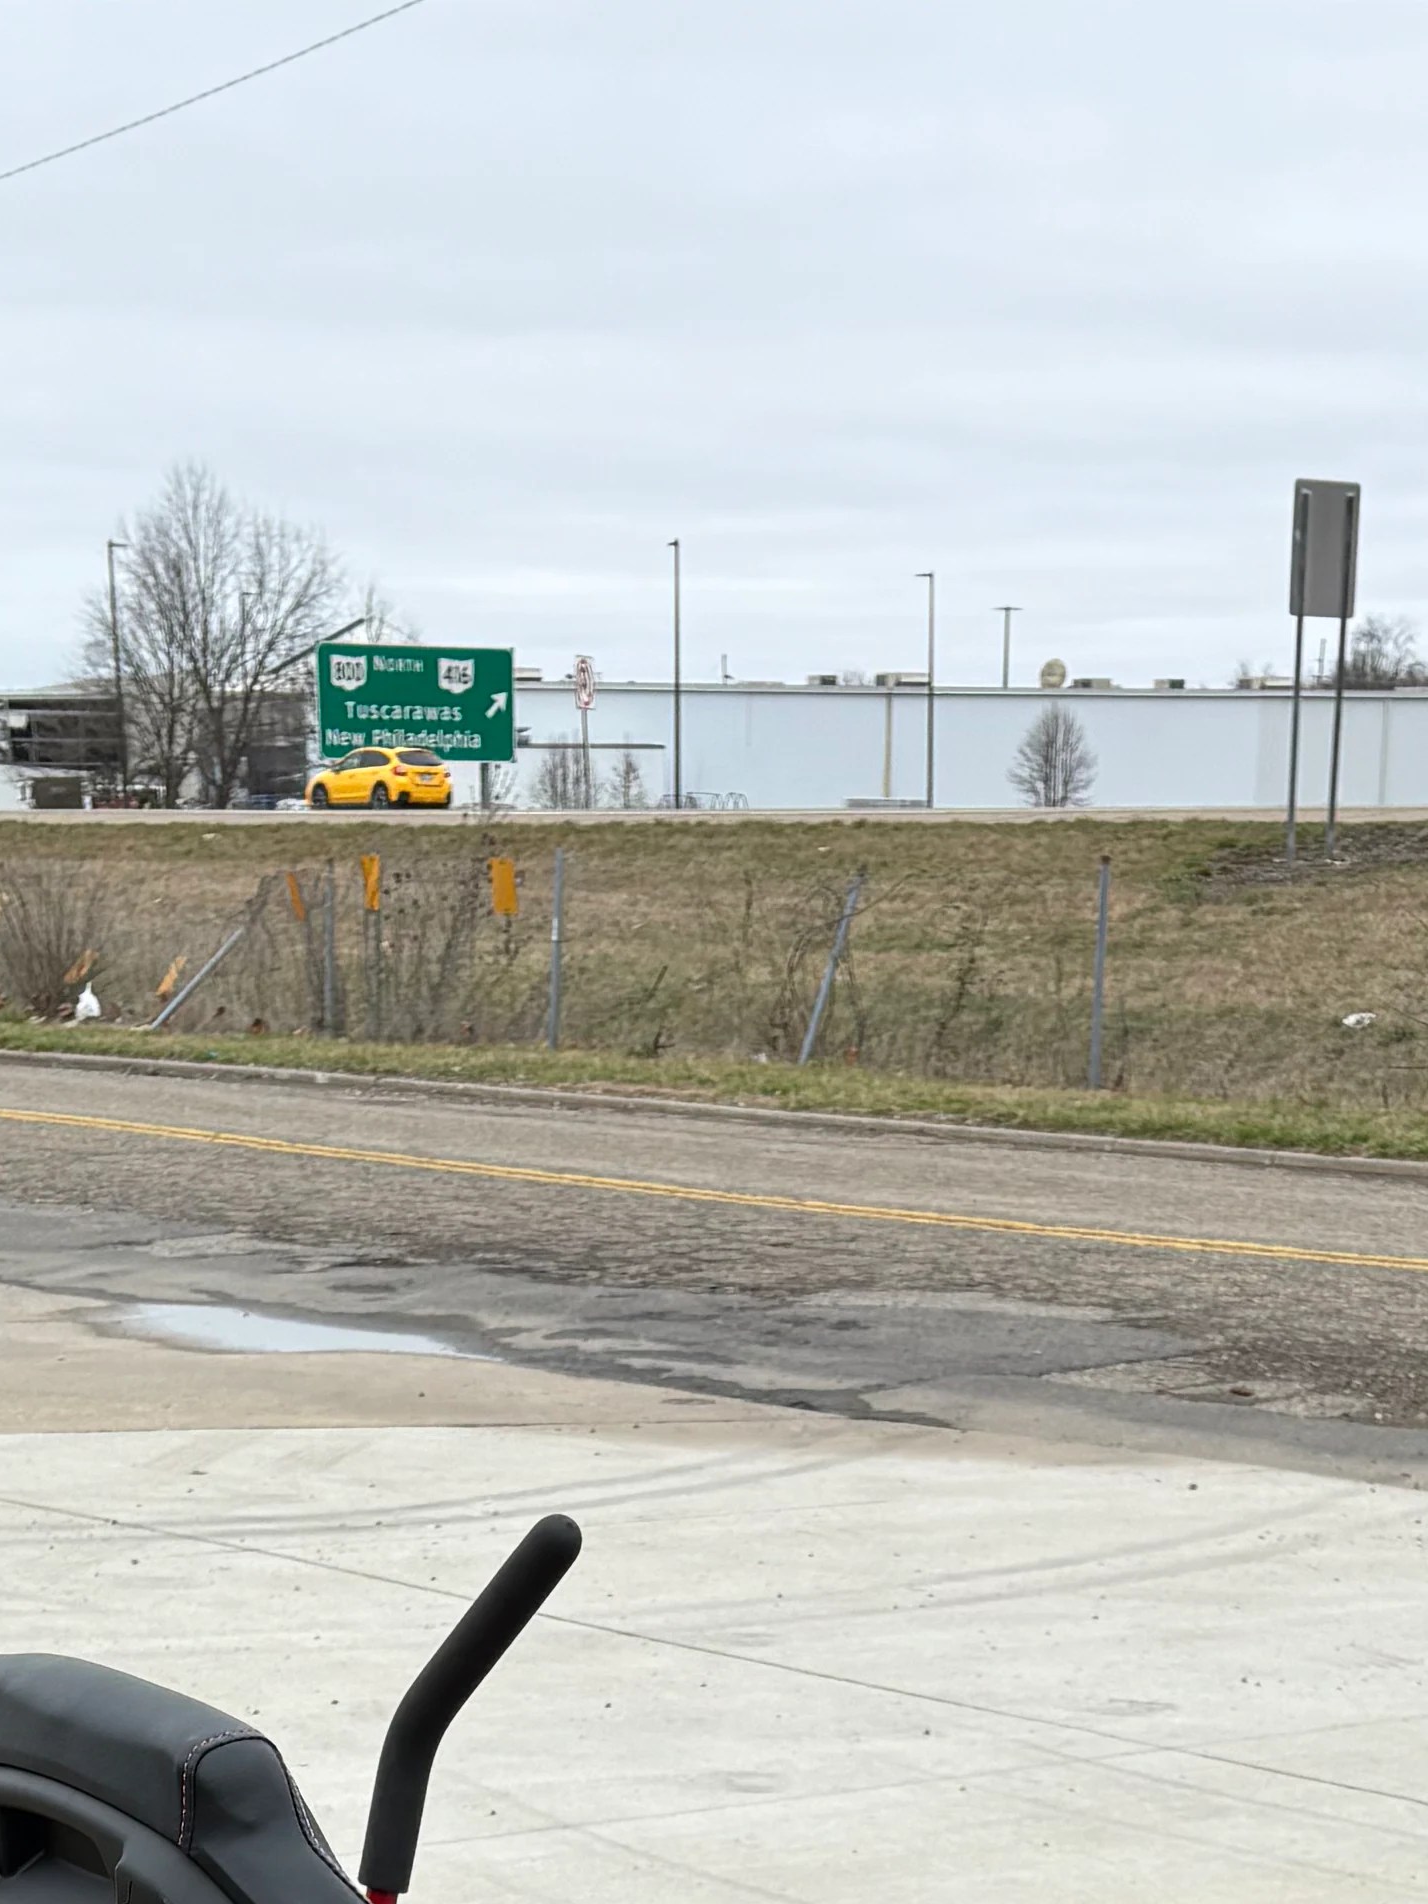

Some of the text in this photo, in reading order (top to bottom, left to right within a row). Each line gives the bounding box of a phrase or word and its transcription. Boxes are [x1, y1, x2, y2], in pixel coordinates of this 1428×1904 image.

[344, 701, 462, 721] Tuscarawas
[325, 728, 481, 751] New Philadelphia
